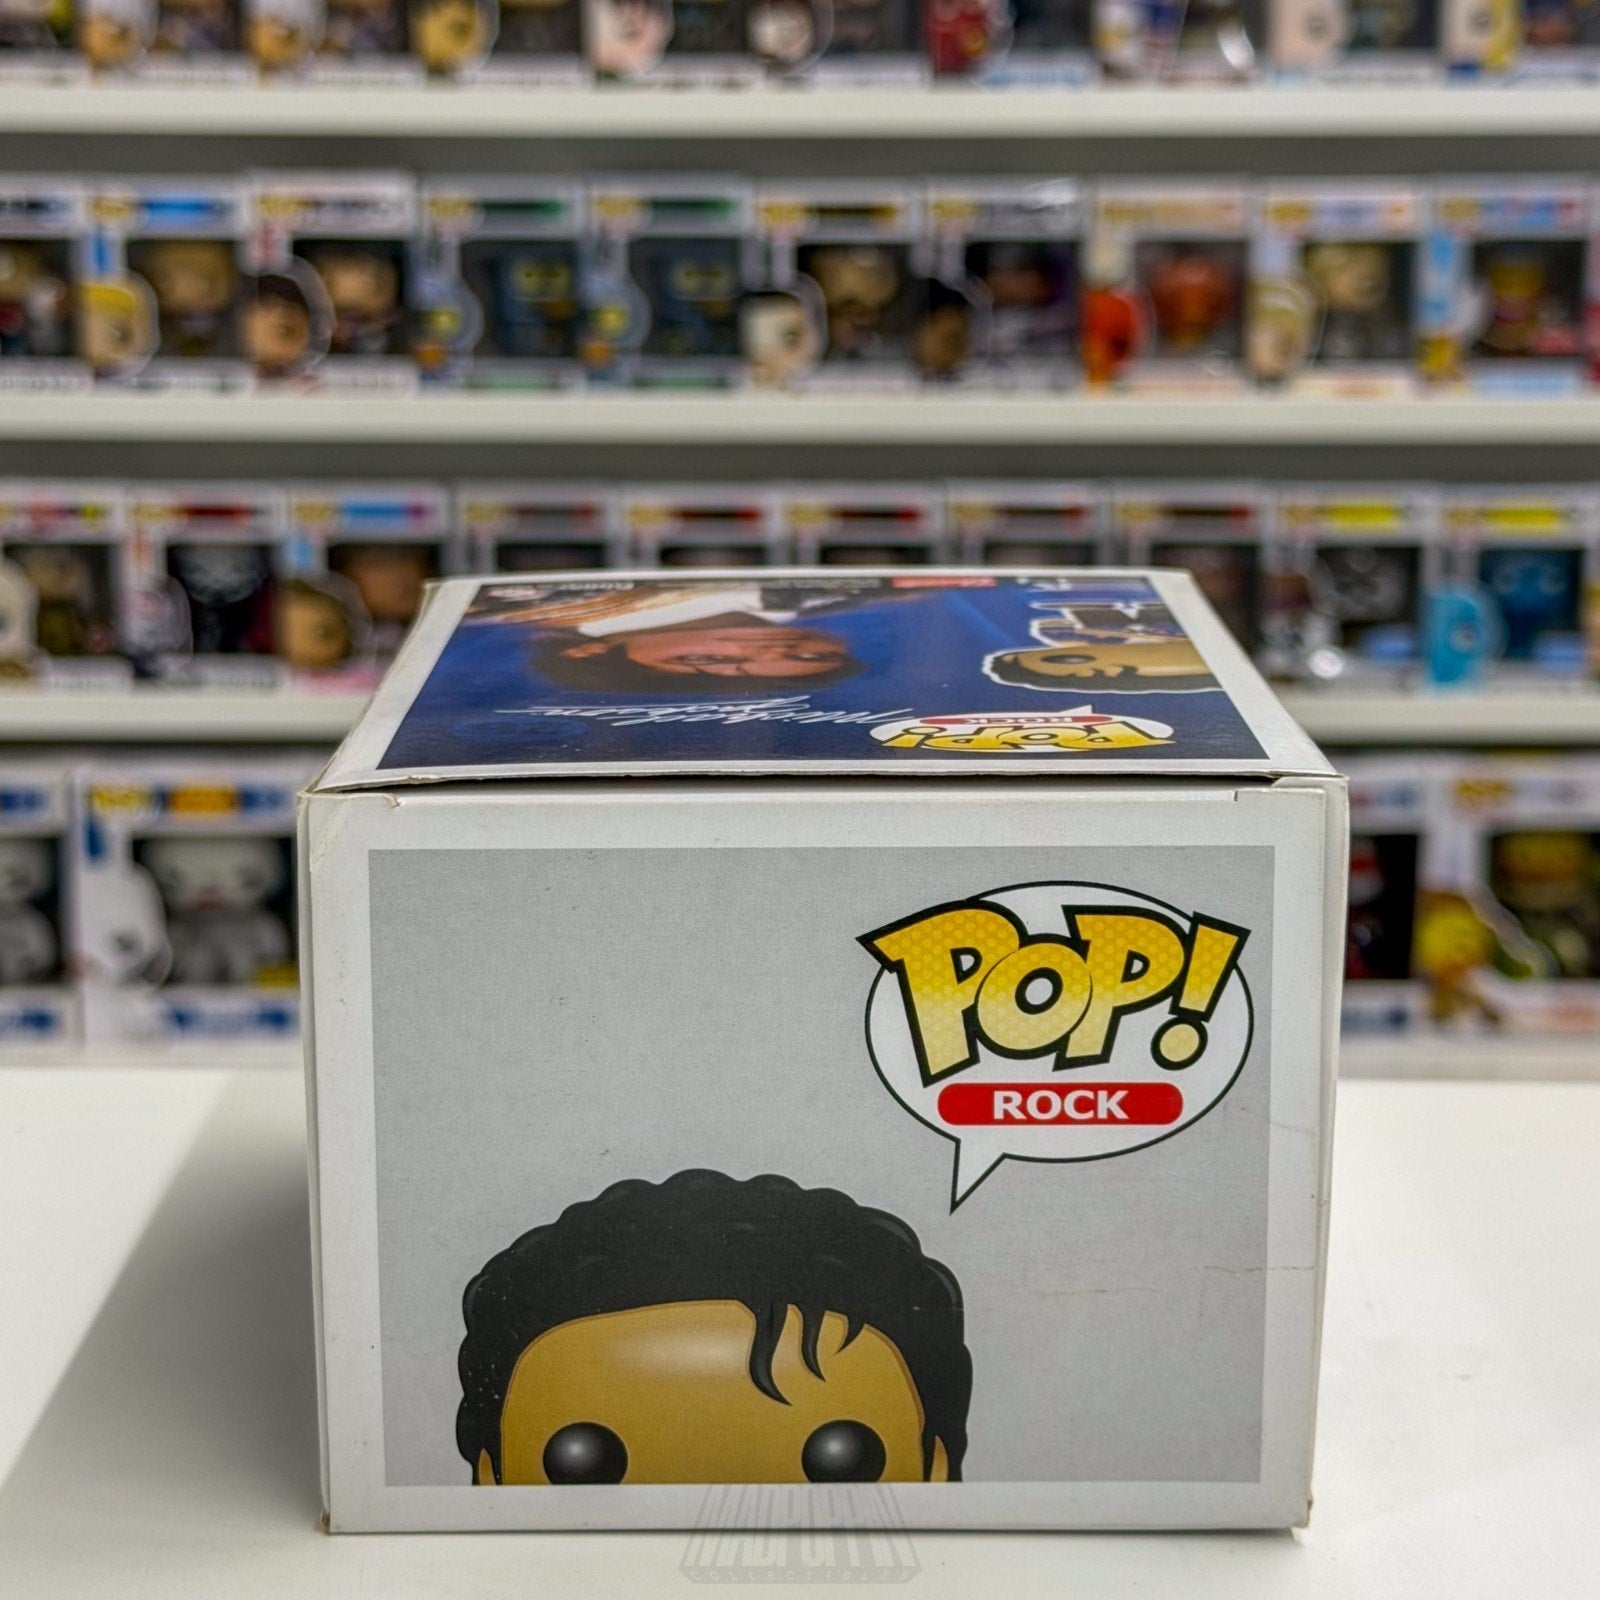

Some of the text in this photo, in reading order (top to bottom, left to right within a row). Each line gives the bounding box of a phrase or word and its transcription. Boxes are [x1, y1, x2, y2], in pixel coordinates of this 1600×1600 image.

[882, 721, 1176, 750] POP!
[964, 717, 1073, 725] ROCK
[855, 899, 1252, 1088] POP!
[993, 1089, 1129, 1121] ROCK
